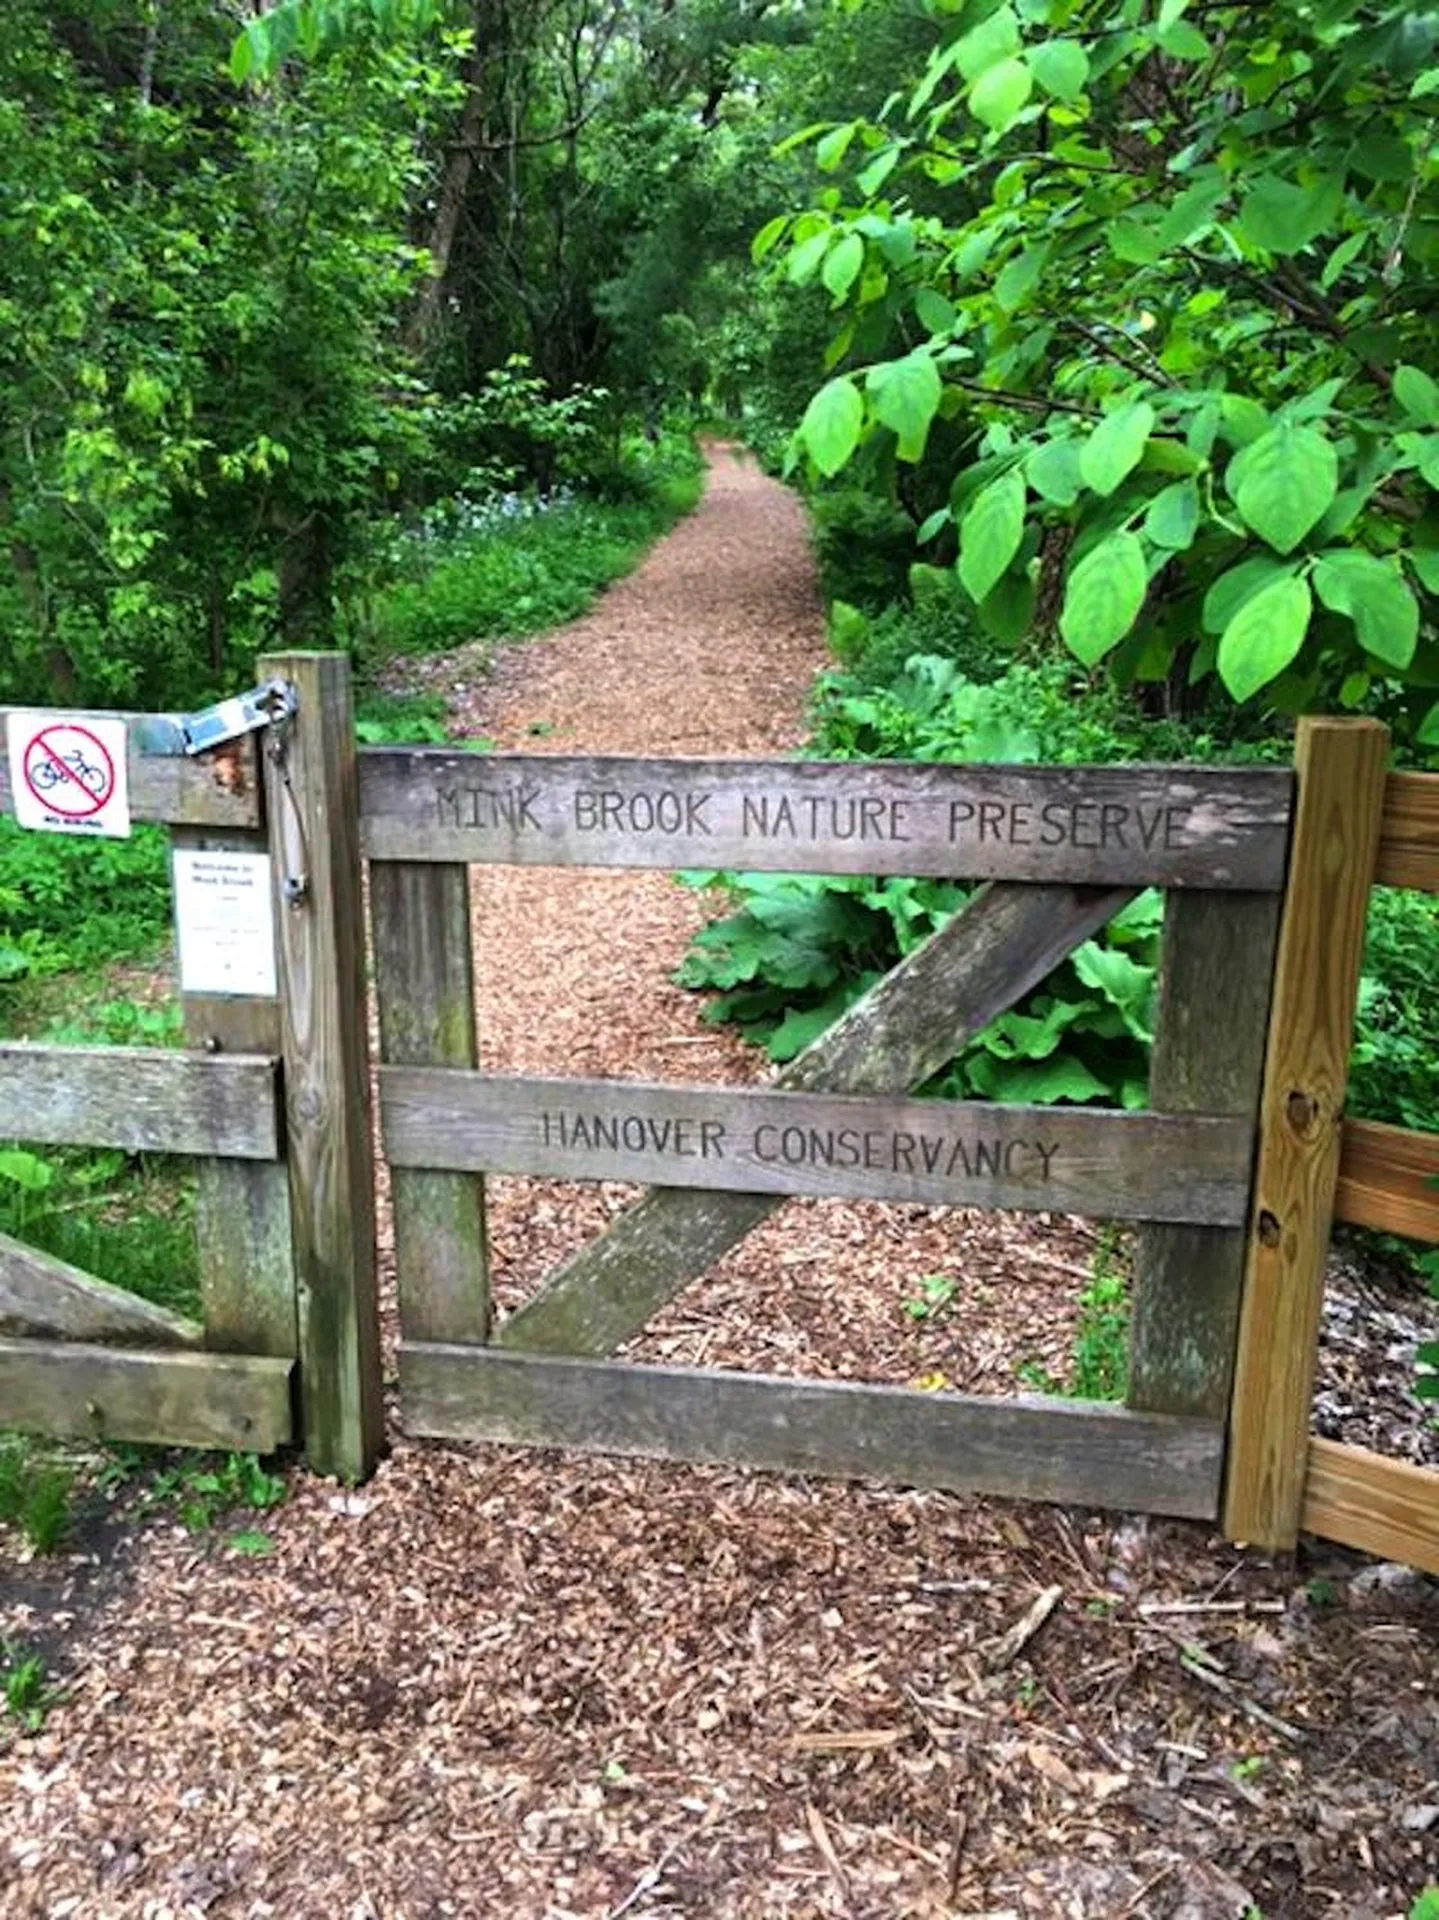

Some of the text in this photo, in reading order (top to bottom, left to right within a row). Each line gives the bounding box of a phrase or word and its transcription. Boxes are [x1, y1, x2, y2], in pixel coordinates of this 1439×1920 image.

[436, 786, 1192, 851] MINK BROOK NATURE PRESERVE
[542, 1112, 1060, 1183] HANOVER CONSERVANCY
